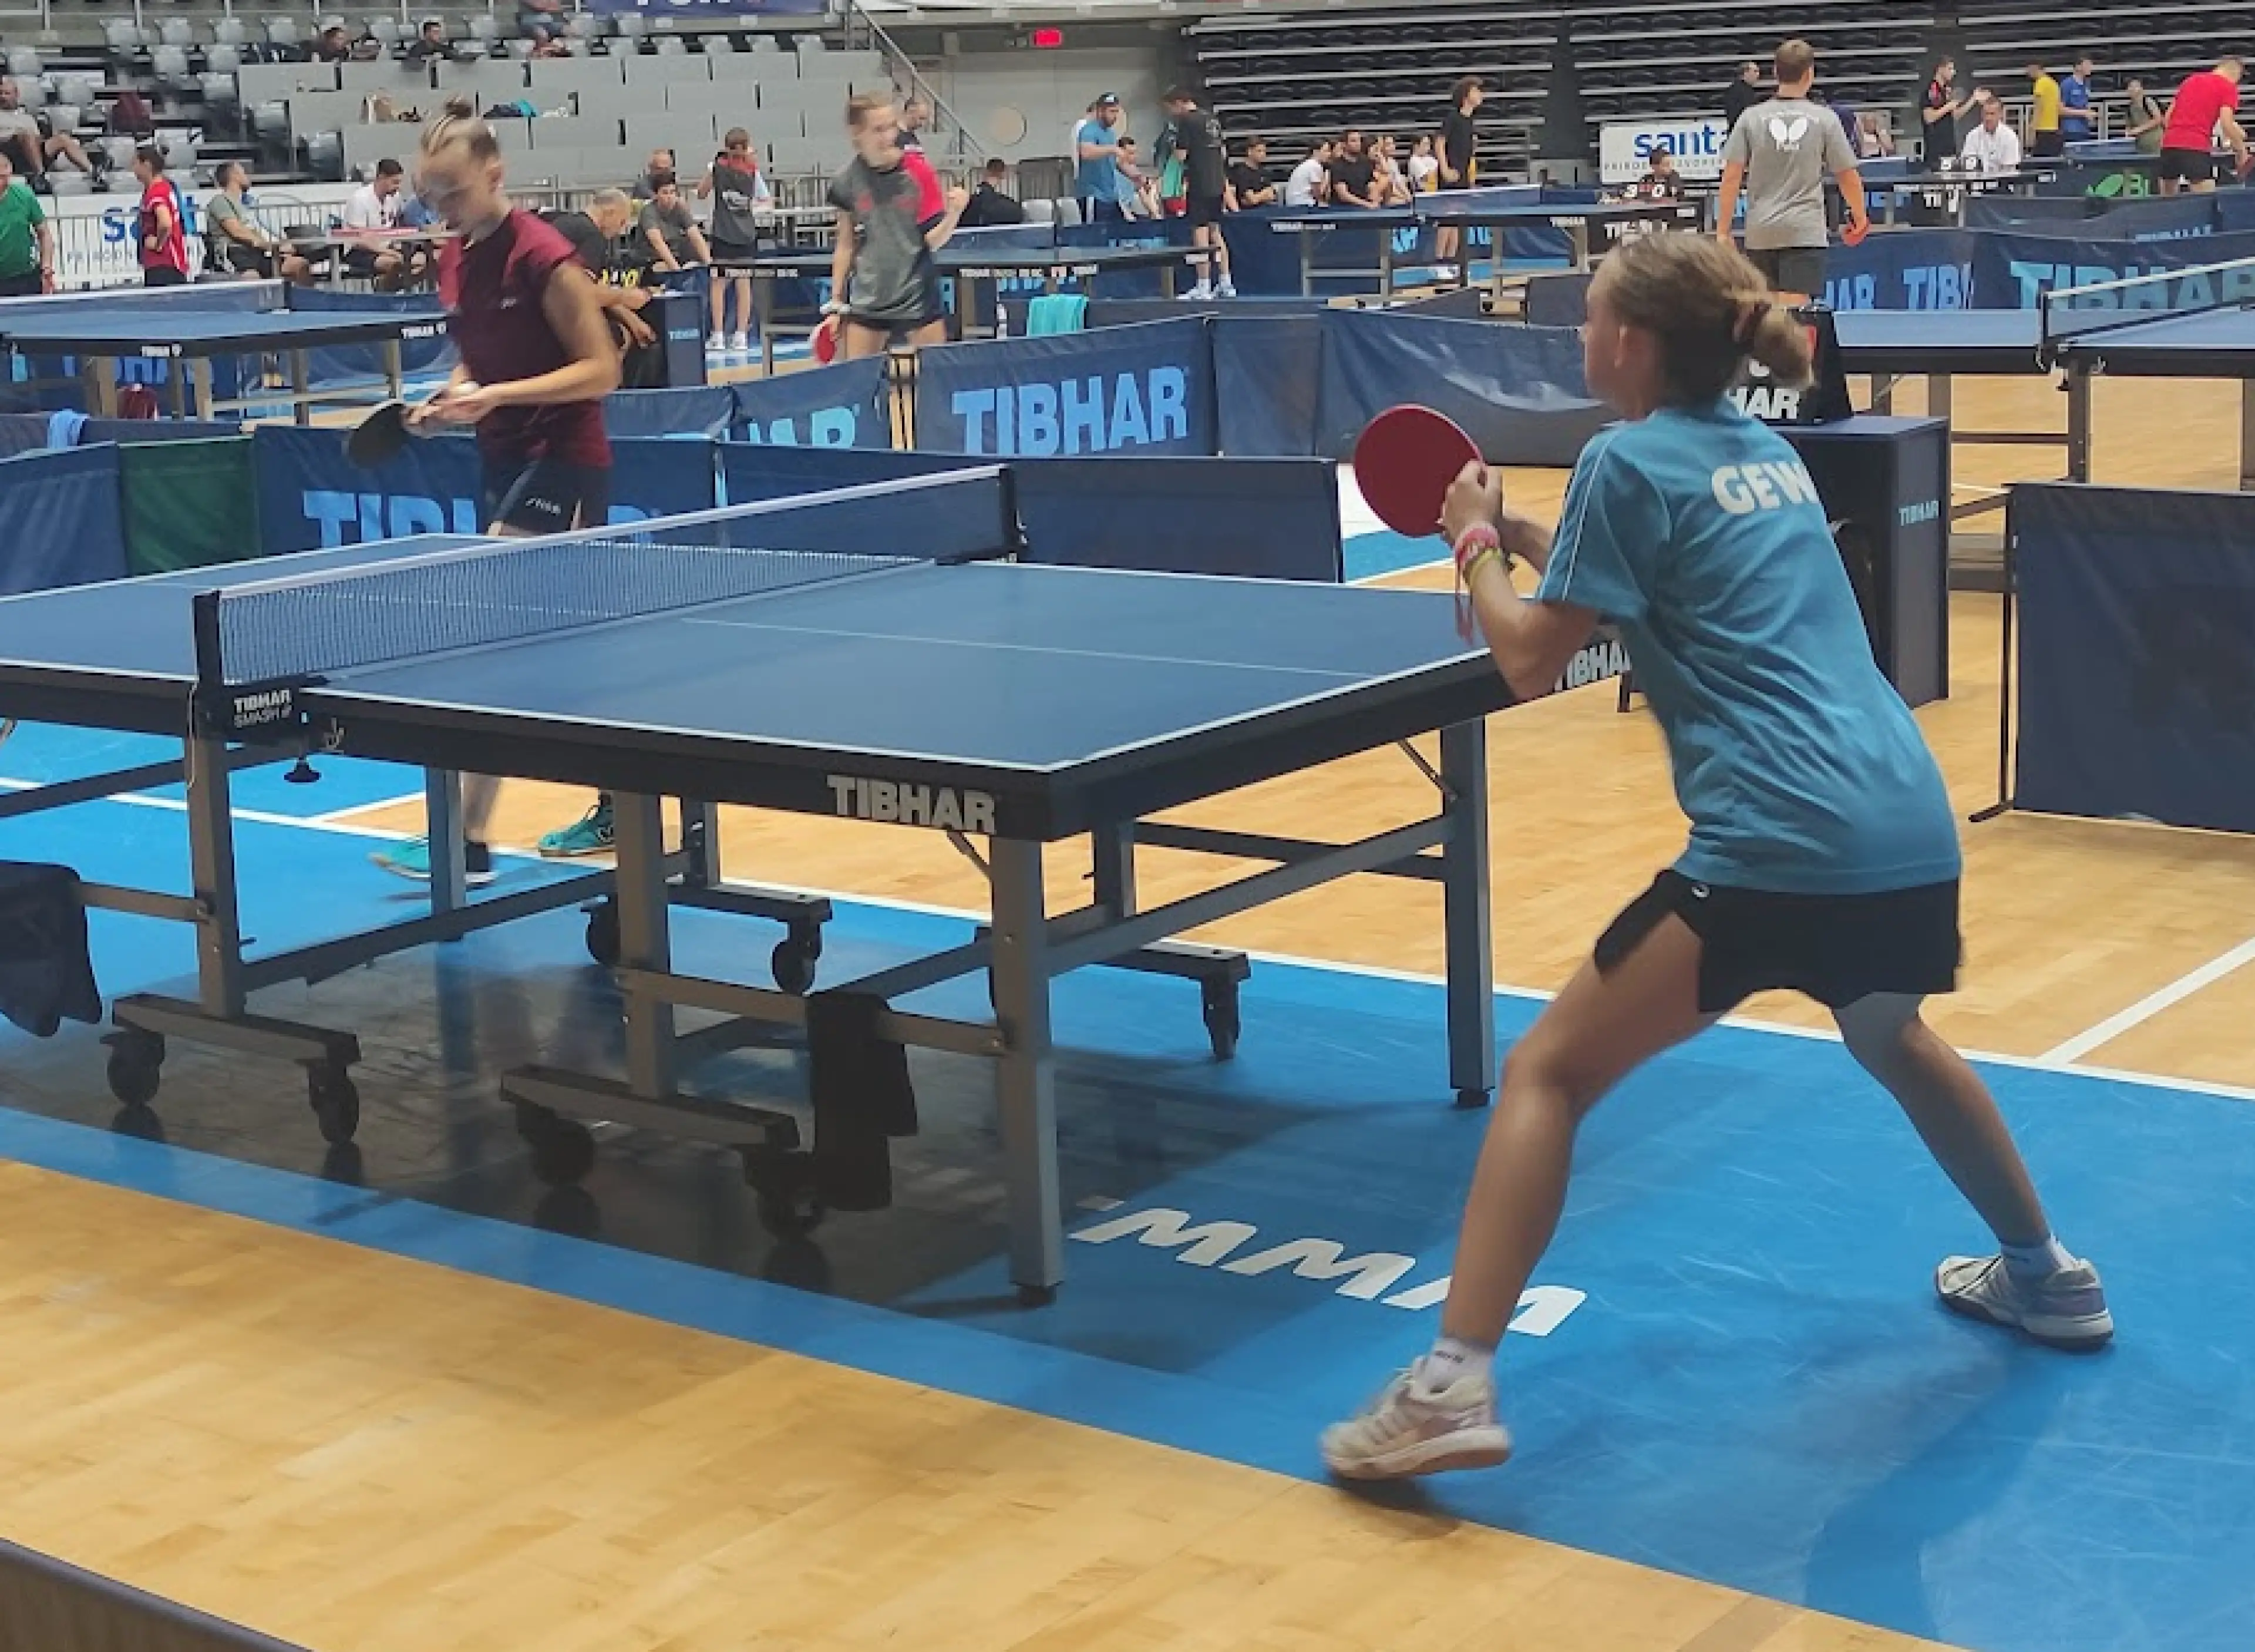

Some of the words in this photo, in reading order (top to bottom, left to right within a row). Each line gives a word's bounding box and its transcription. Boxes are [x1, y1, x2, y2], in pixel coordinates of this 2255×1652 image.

[952, 366, 1187, 456] TIBHAR
[1899, 500, 1940, 526] TIBHAR
[234, 689, 291, 713] TIBHAR
[827, 774, 997, 835] TIBHAR
